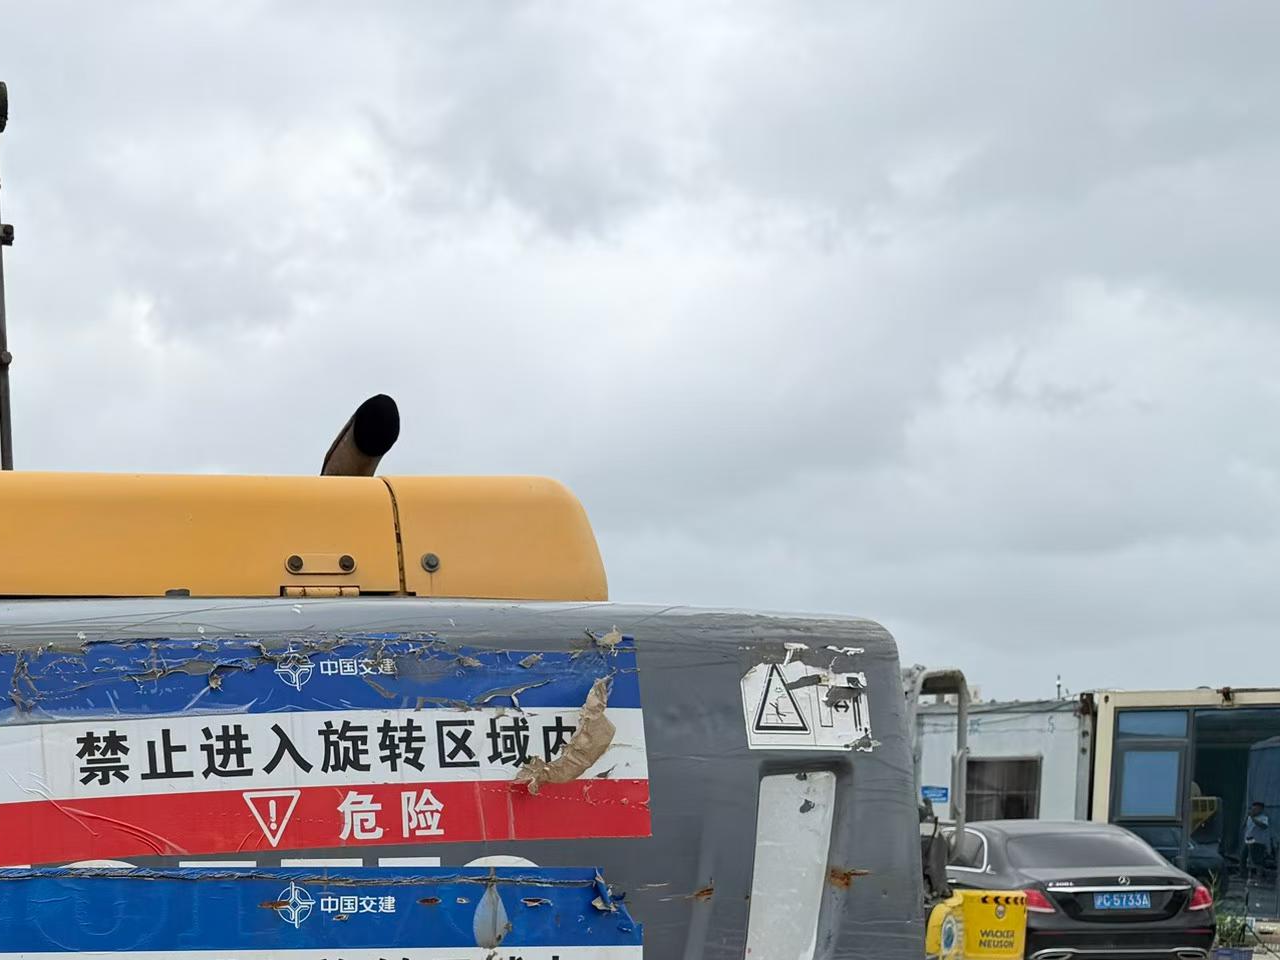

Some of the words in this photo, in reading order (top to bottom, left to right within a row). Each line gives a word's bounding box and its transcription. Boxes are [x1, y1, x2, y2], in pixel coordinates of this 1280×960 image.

[320, 658, 397, 676] 中国交建
[338, 788, 445, 842] 危险
[320, 896, 396, 913] 中国交建
[979, 939, 1014, 949] NEUSON
